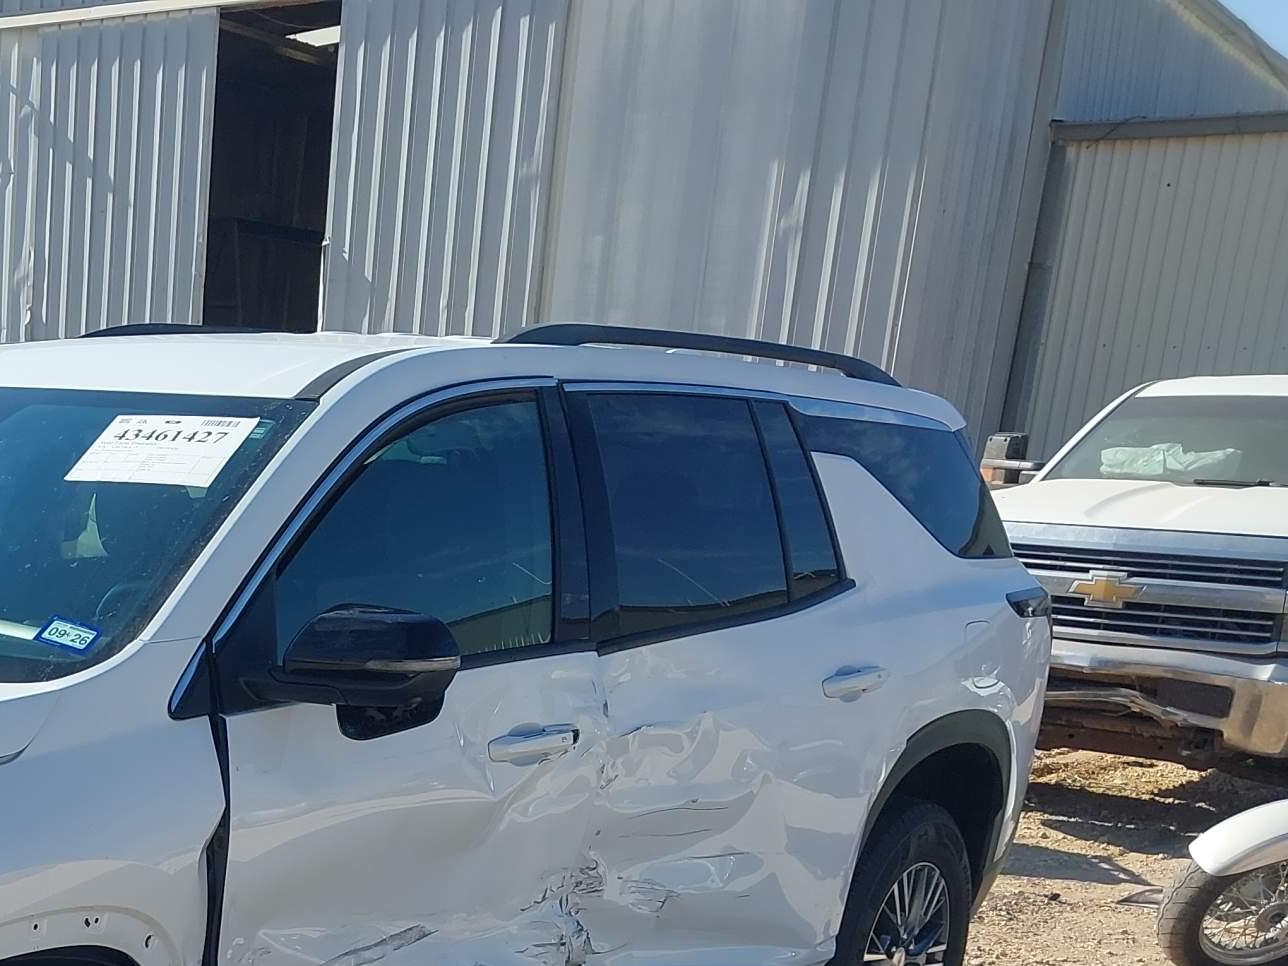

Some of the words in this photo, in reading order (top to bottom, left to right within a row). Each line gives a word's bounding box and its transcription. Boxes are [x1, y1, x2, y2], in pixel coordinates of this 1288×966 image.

[114, 428, 229, 444] 43461427
[48, 626, 68, 639] 09
[69, 633, 91, 646] 26
